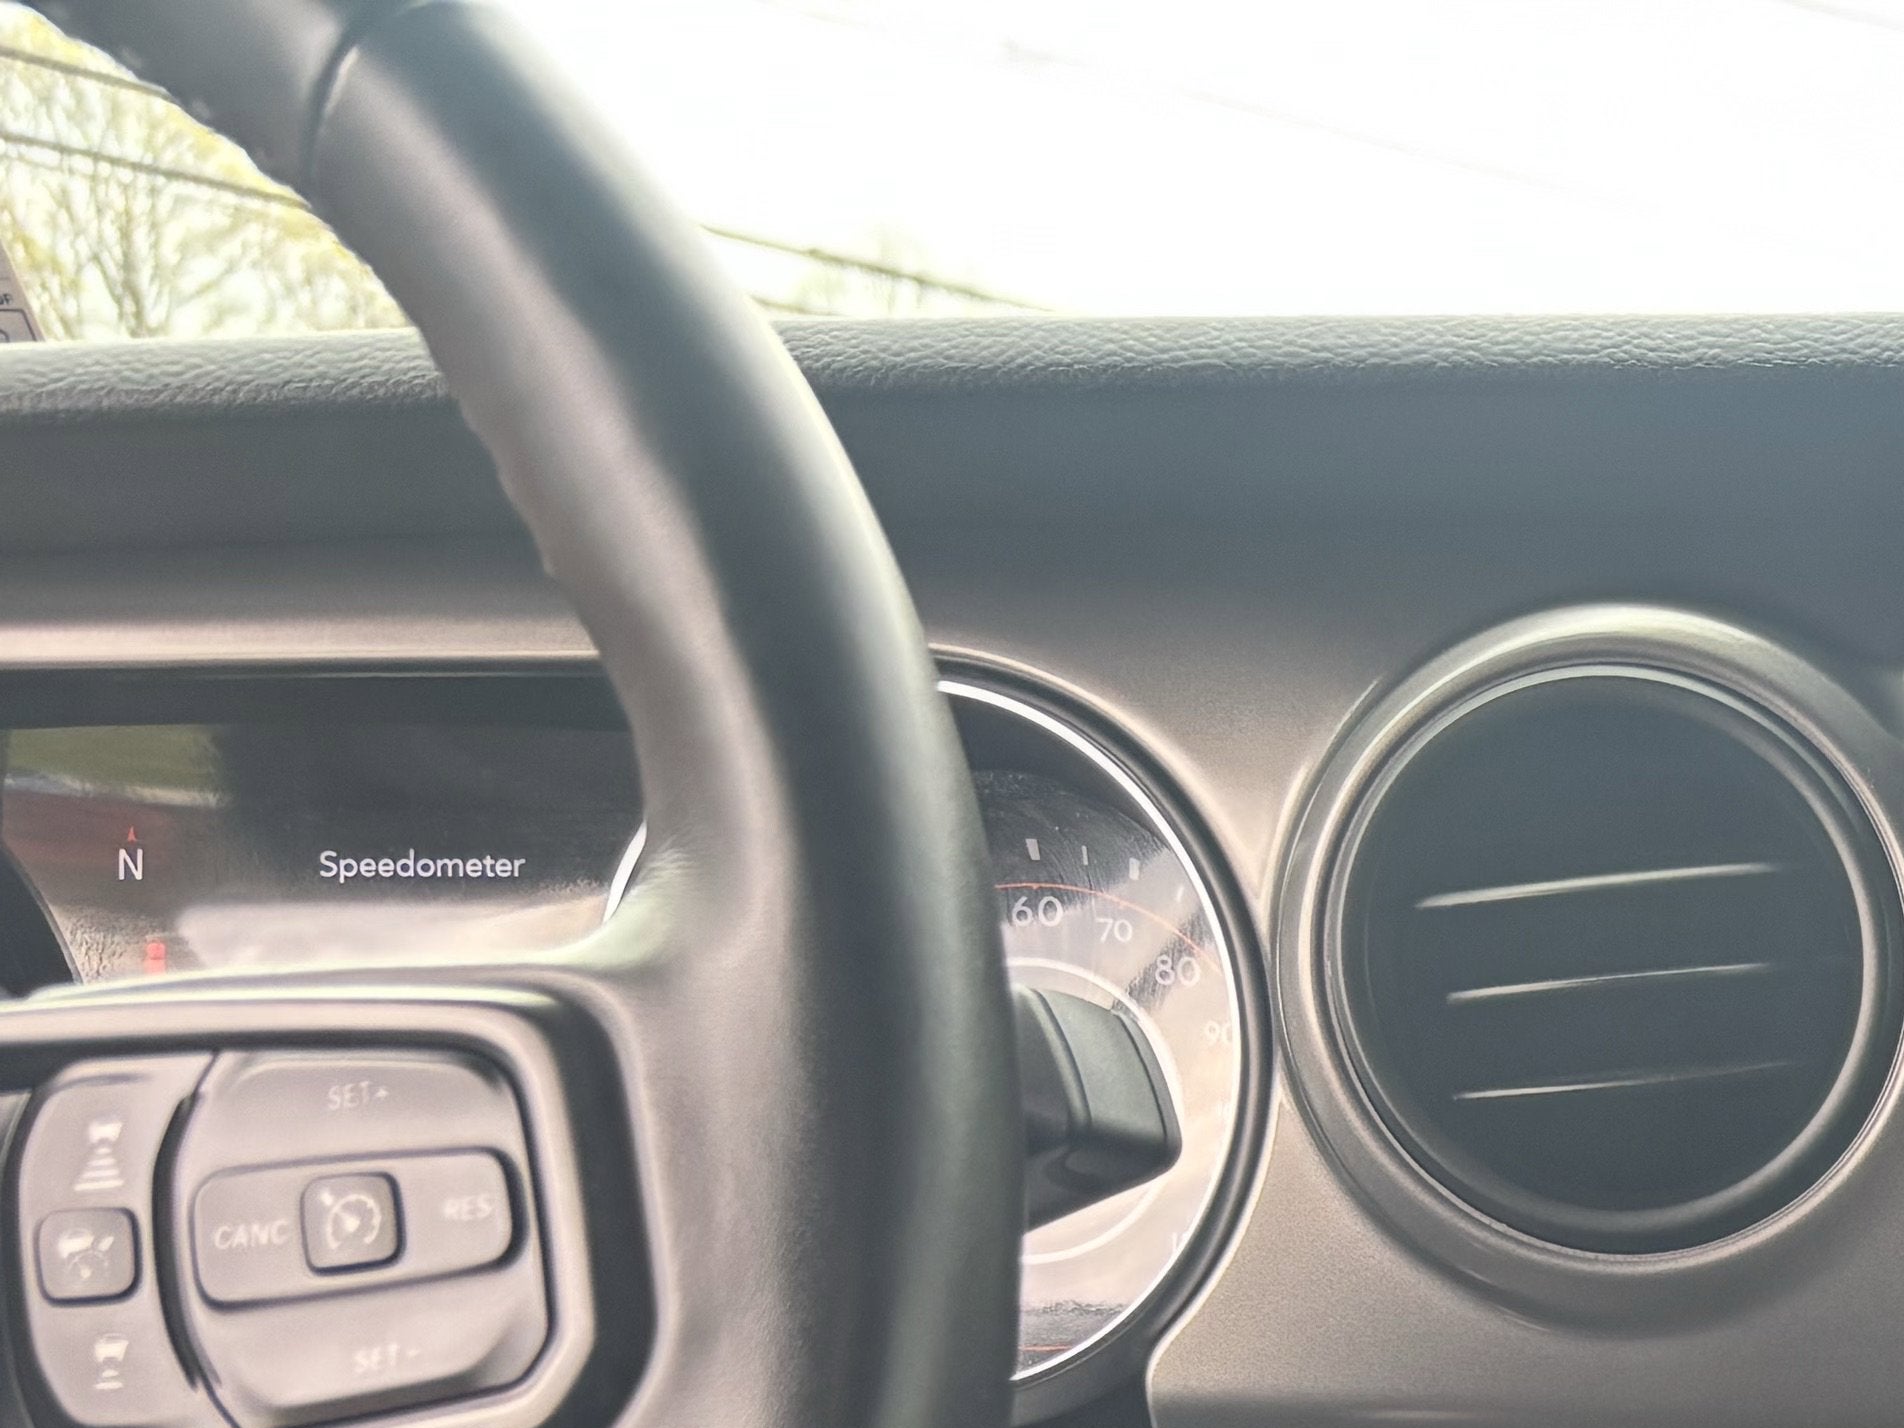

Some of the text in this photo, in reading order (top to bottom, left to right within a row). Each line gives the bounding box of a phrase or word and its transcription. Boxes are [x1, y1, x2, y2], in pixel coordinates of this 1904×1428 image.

[118, 849, 143, 881] N
[318, 849, 526, 883] Speedometer
[1012, 895, 1064, 927] 60
[1095, 918, 1133, 944] 70
[1155, 954, 1200, 987] 80
[443, 1194, 494, 1222] RES
[213, 1220, 289, 1250] CANC
